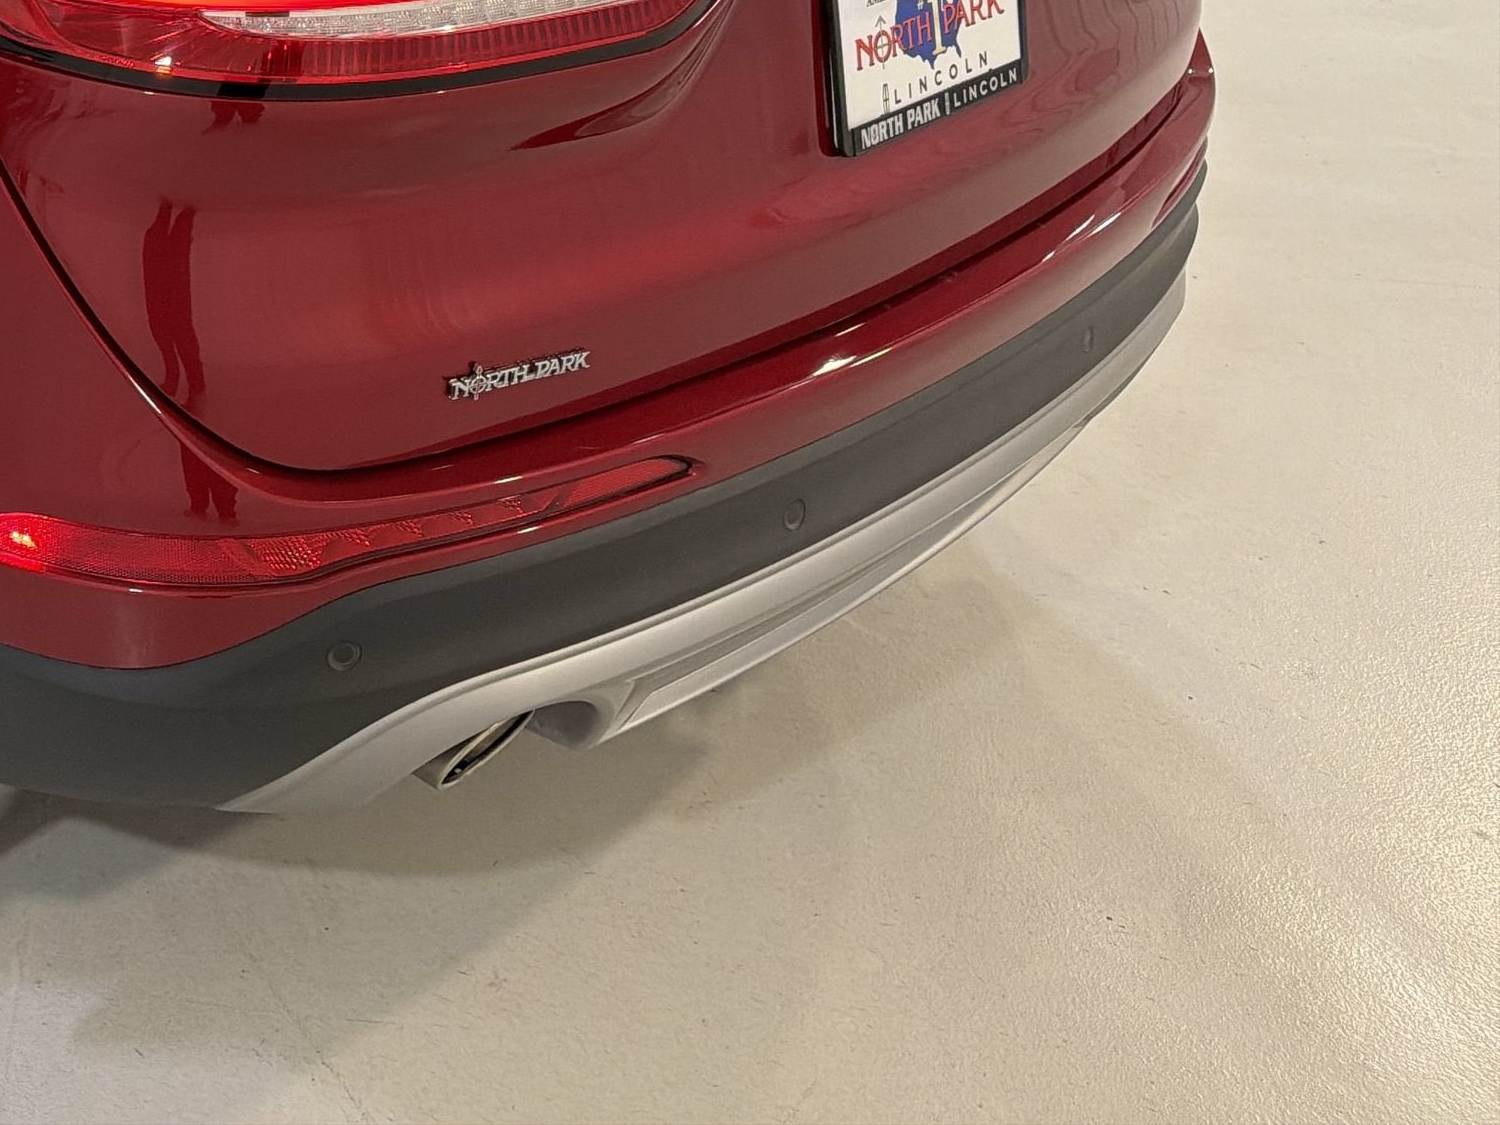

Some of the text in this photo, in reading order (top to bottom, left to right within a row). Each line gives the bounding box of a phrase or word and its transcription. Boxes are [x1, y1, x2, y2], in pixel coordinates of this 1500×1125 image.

[854, 10, 933, 71] NORTH
[894, 51, 988, 105] LINCOLN
[861, 67, 1018, 150] NORTH PARK LINCOLN
[449, 351, 591, 400] NORTH PARK
